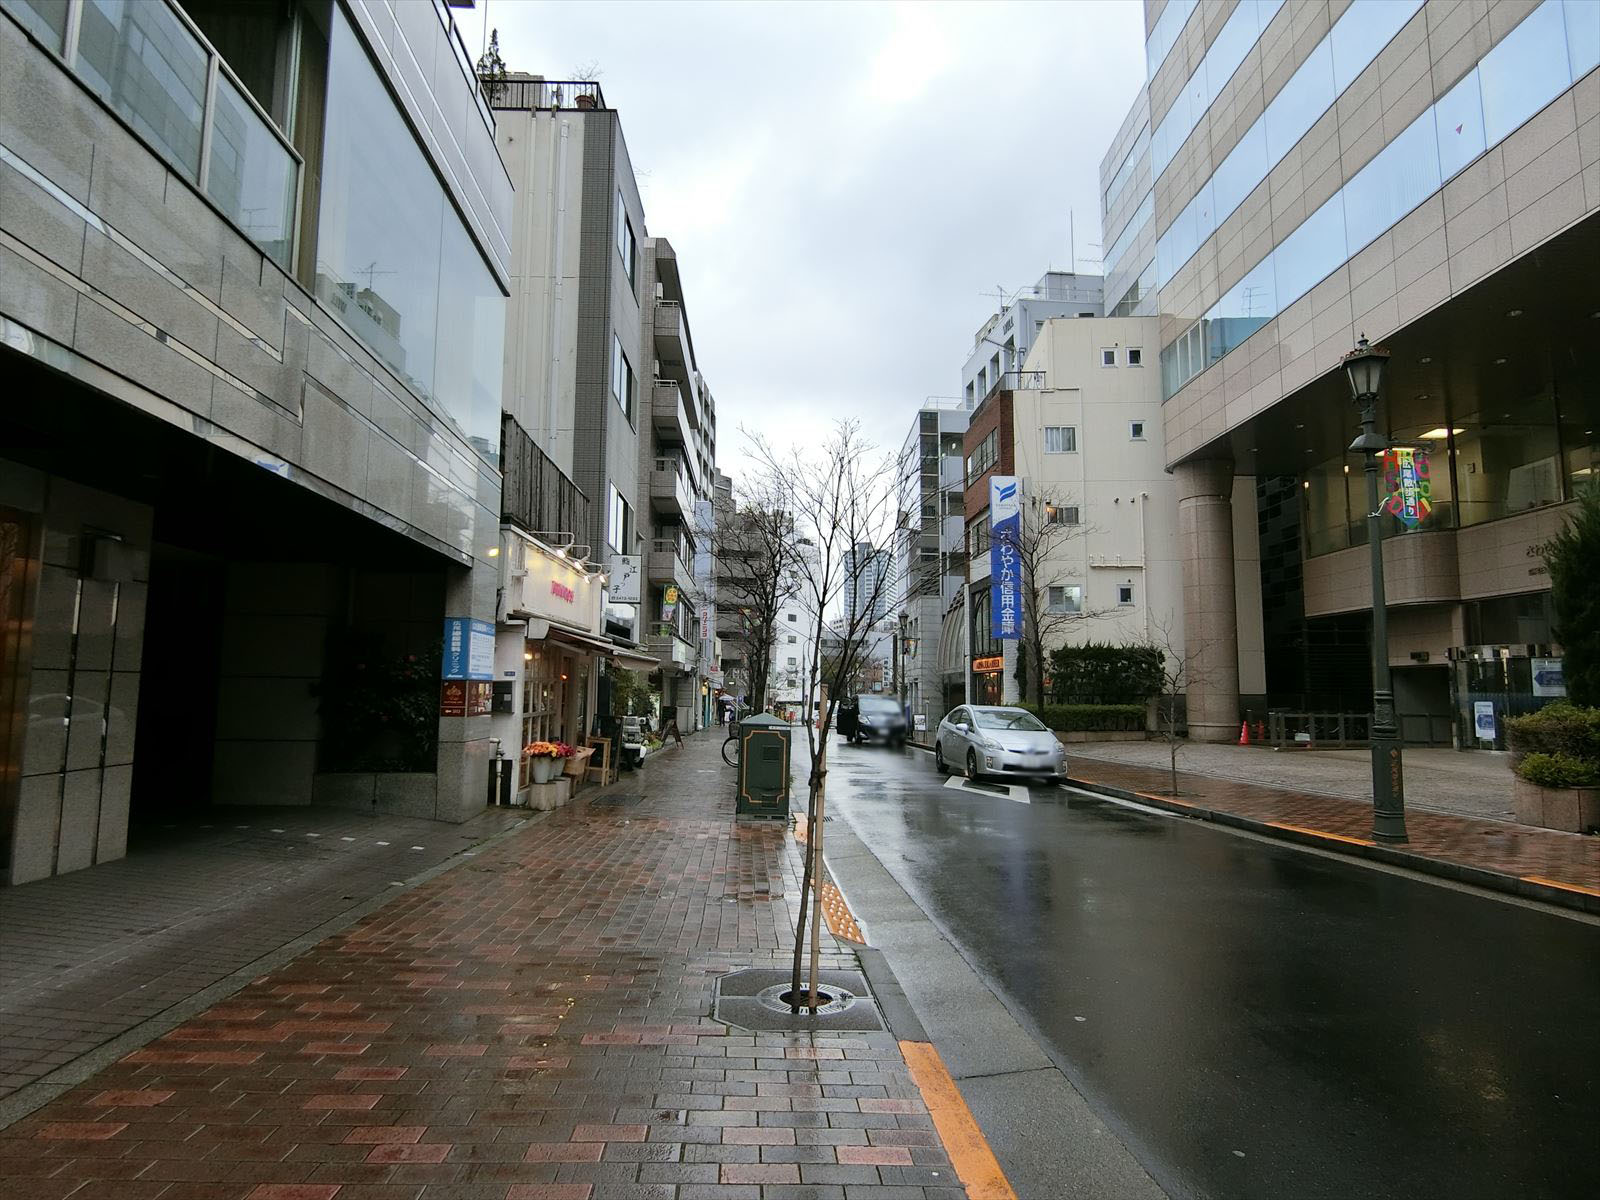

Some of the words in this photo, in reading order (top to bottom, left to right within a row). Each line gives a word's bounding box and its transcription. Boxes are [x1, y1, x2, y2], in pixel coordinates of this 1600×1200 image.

[1000, 528, 1015, 635] さわやか信用金庫
